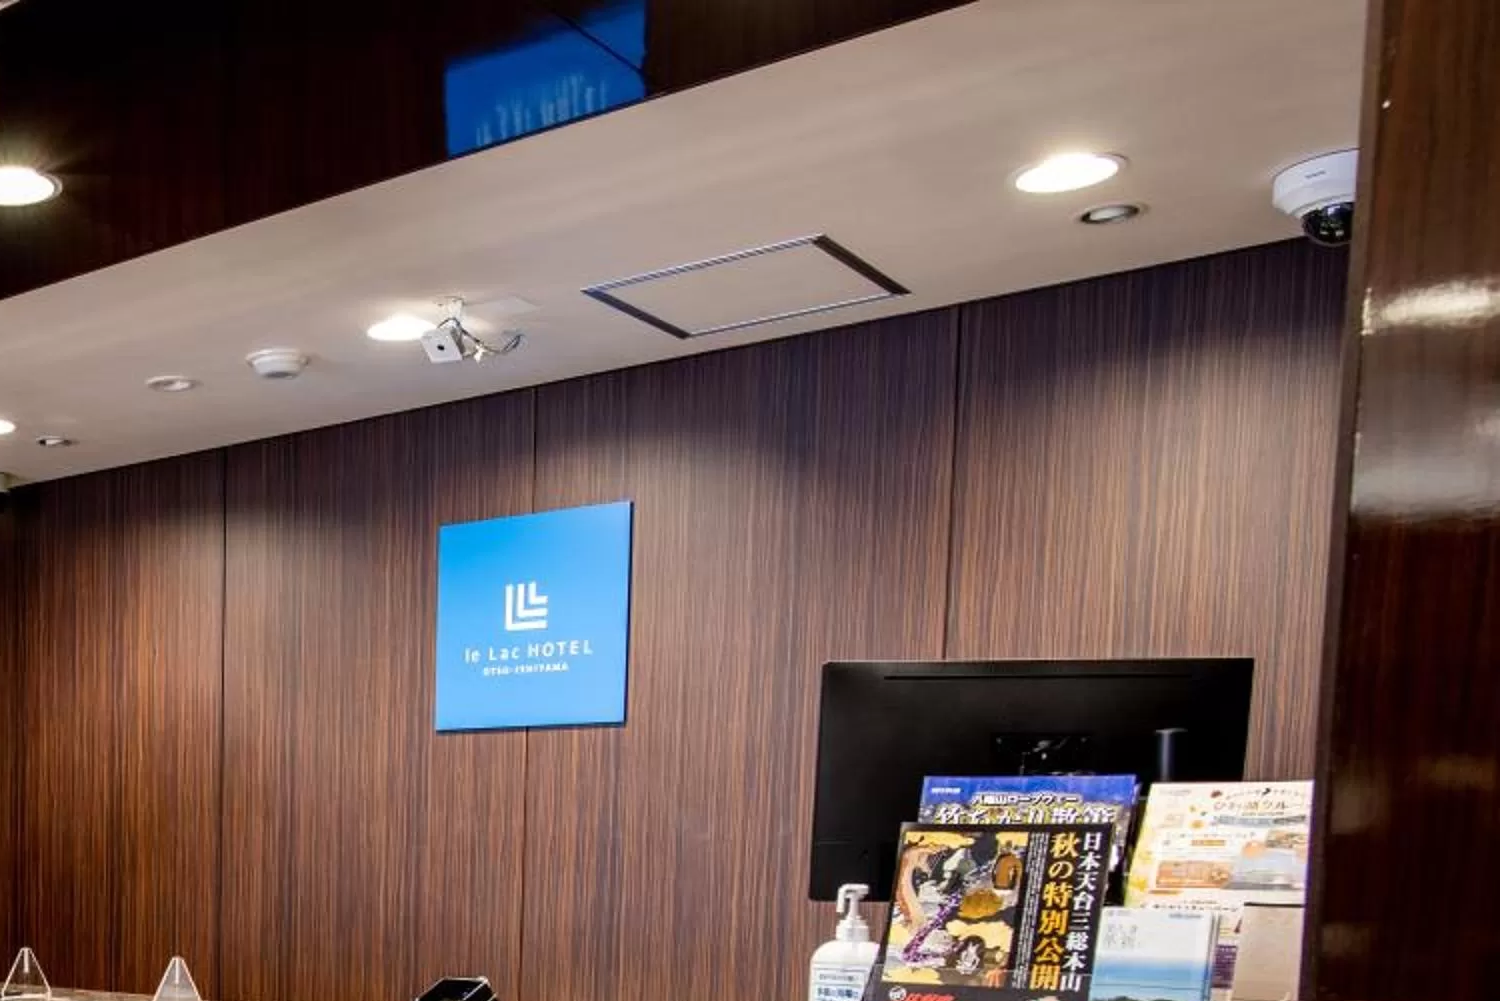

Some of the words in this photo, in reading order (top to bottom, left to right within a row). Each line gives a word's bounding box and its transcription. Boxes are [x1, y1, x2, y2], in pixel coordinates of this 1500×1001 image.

[464, 648, 481, 664] le
[488, 645, 520, 660] Lac
[528, 640, 593, 657] HOTEL
[1029, 831, 1080, 991] 秋の特別公開
[1059, 831, 1102, 992] 日本天台三総本山
